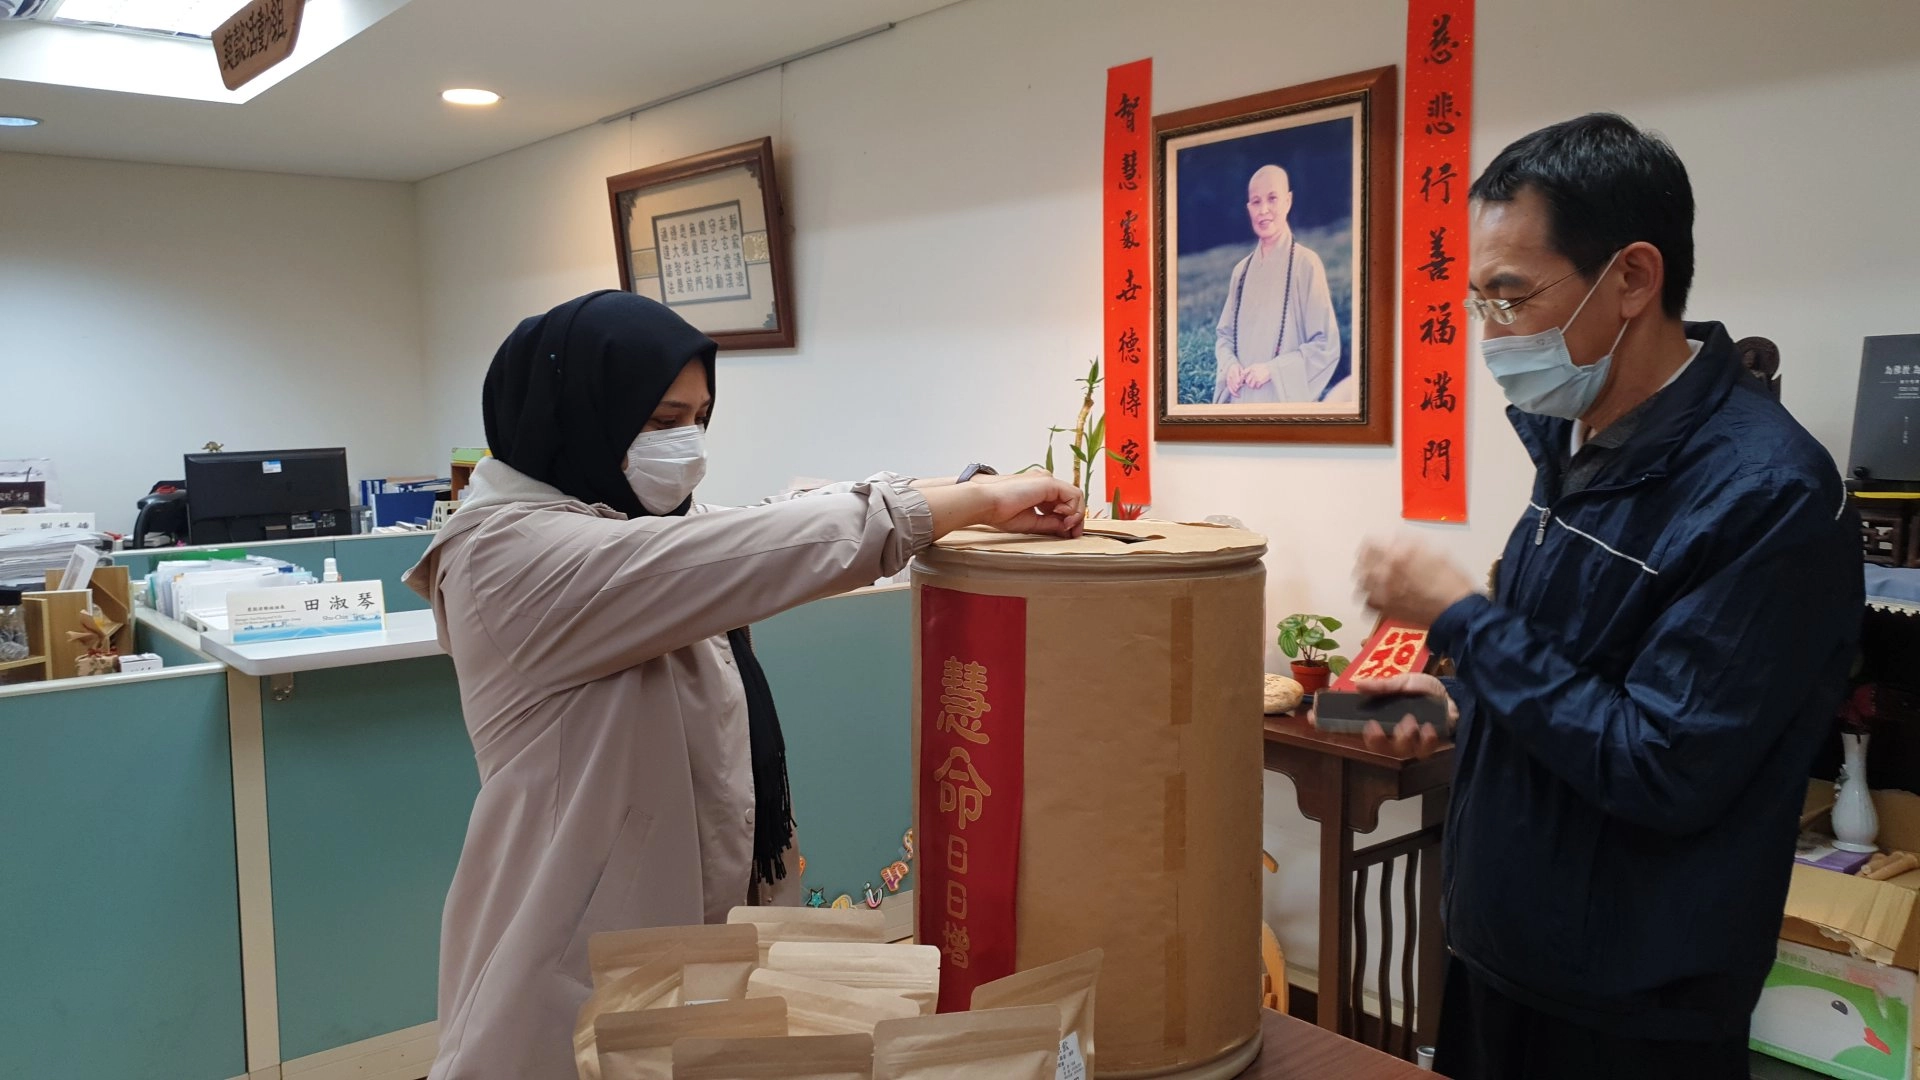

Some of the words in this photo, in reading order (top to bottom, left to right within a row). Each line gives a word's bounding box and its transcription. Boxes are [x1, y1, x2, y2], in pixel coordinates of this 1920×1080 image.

[689, 222, 704, 291] 無量法門
[708, 218, 723, 289] 守之不動
[1417, 13, 1462, 482] 慈悲行善福滿門
[304, 591, 376, 611] 田淑琴
[934, 655, 992, 969] 慧命日日增
